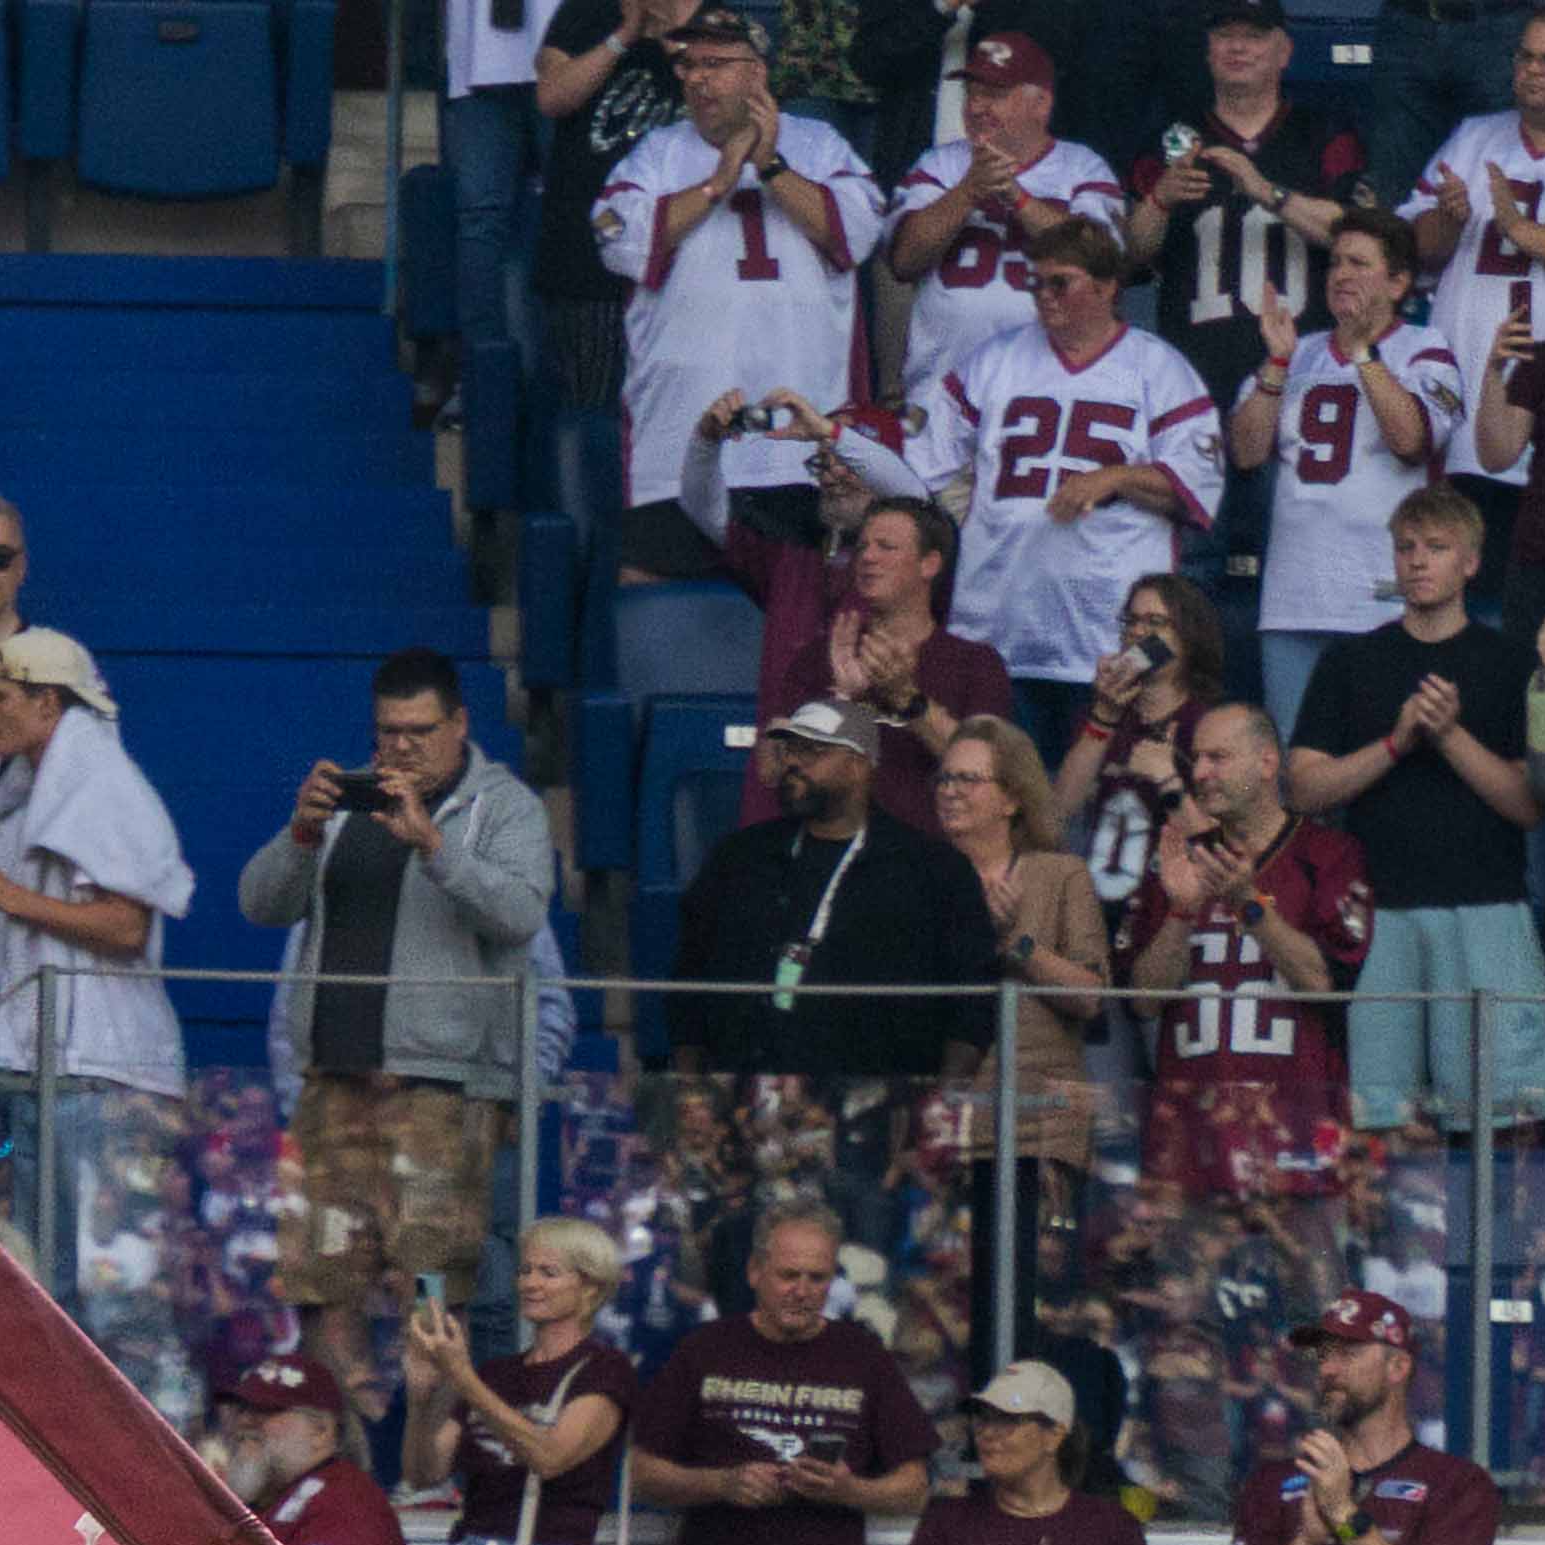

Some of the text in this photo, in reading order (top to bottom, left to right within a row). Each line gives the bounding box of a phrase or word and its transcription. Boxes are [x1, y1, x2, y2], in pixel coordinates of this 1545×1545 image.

[729, 188, 780, 281] 1
[1191, 203, 1308, 324] 10
[994, 396, 1137, 503] 25
[1297, 384, 1359, 485] 9
[701, 1377, 865, 1413] RHEIN FIRE
